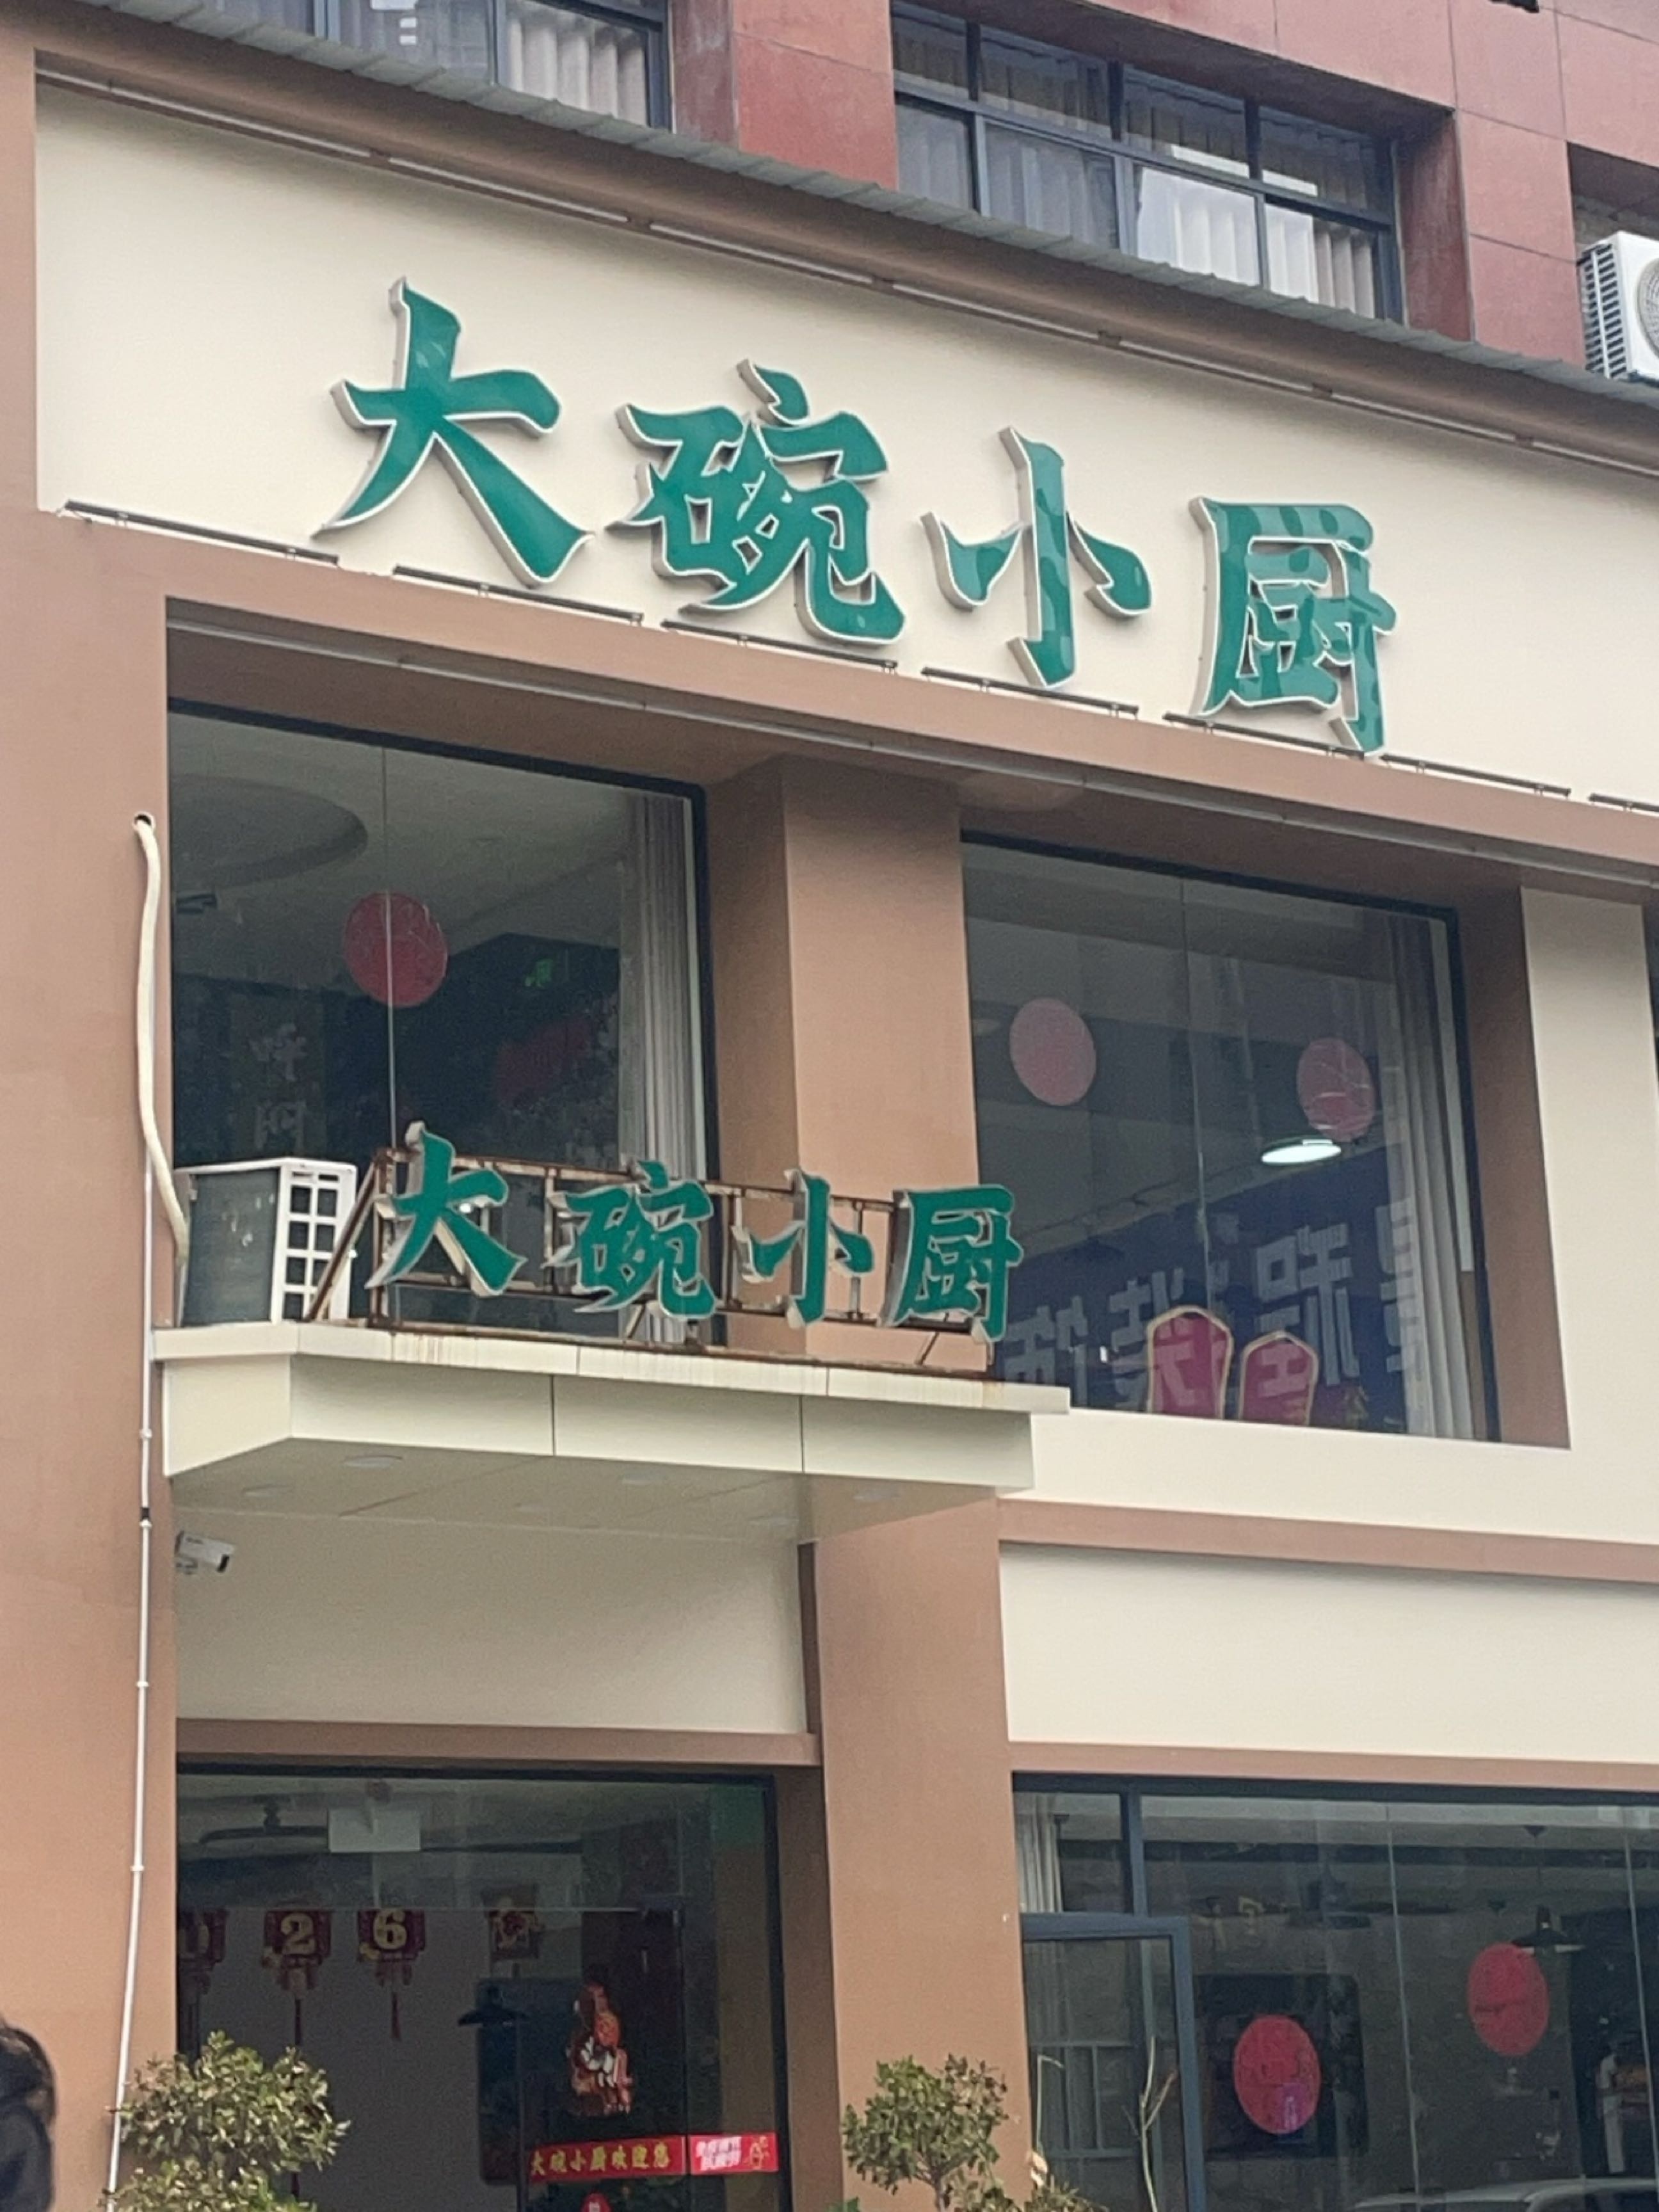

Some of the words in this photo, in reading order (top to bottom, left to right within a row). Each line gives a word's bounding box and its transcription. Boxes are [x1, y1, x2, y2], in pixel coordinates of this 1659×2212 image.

[312, 277, 1398, 757] 大碗小厨
[365, 1121, 1022, 1342] 大碗小厨
